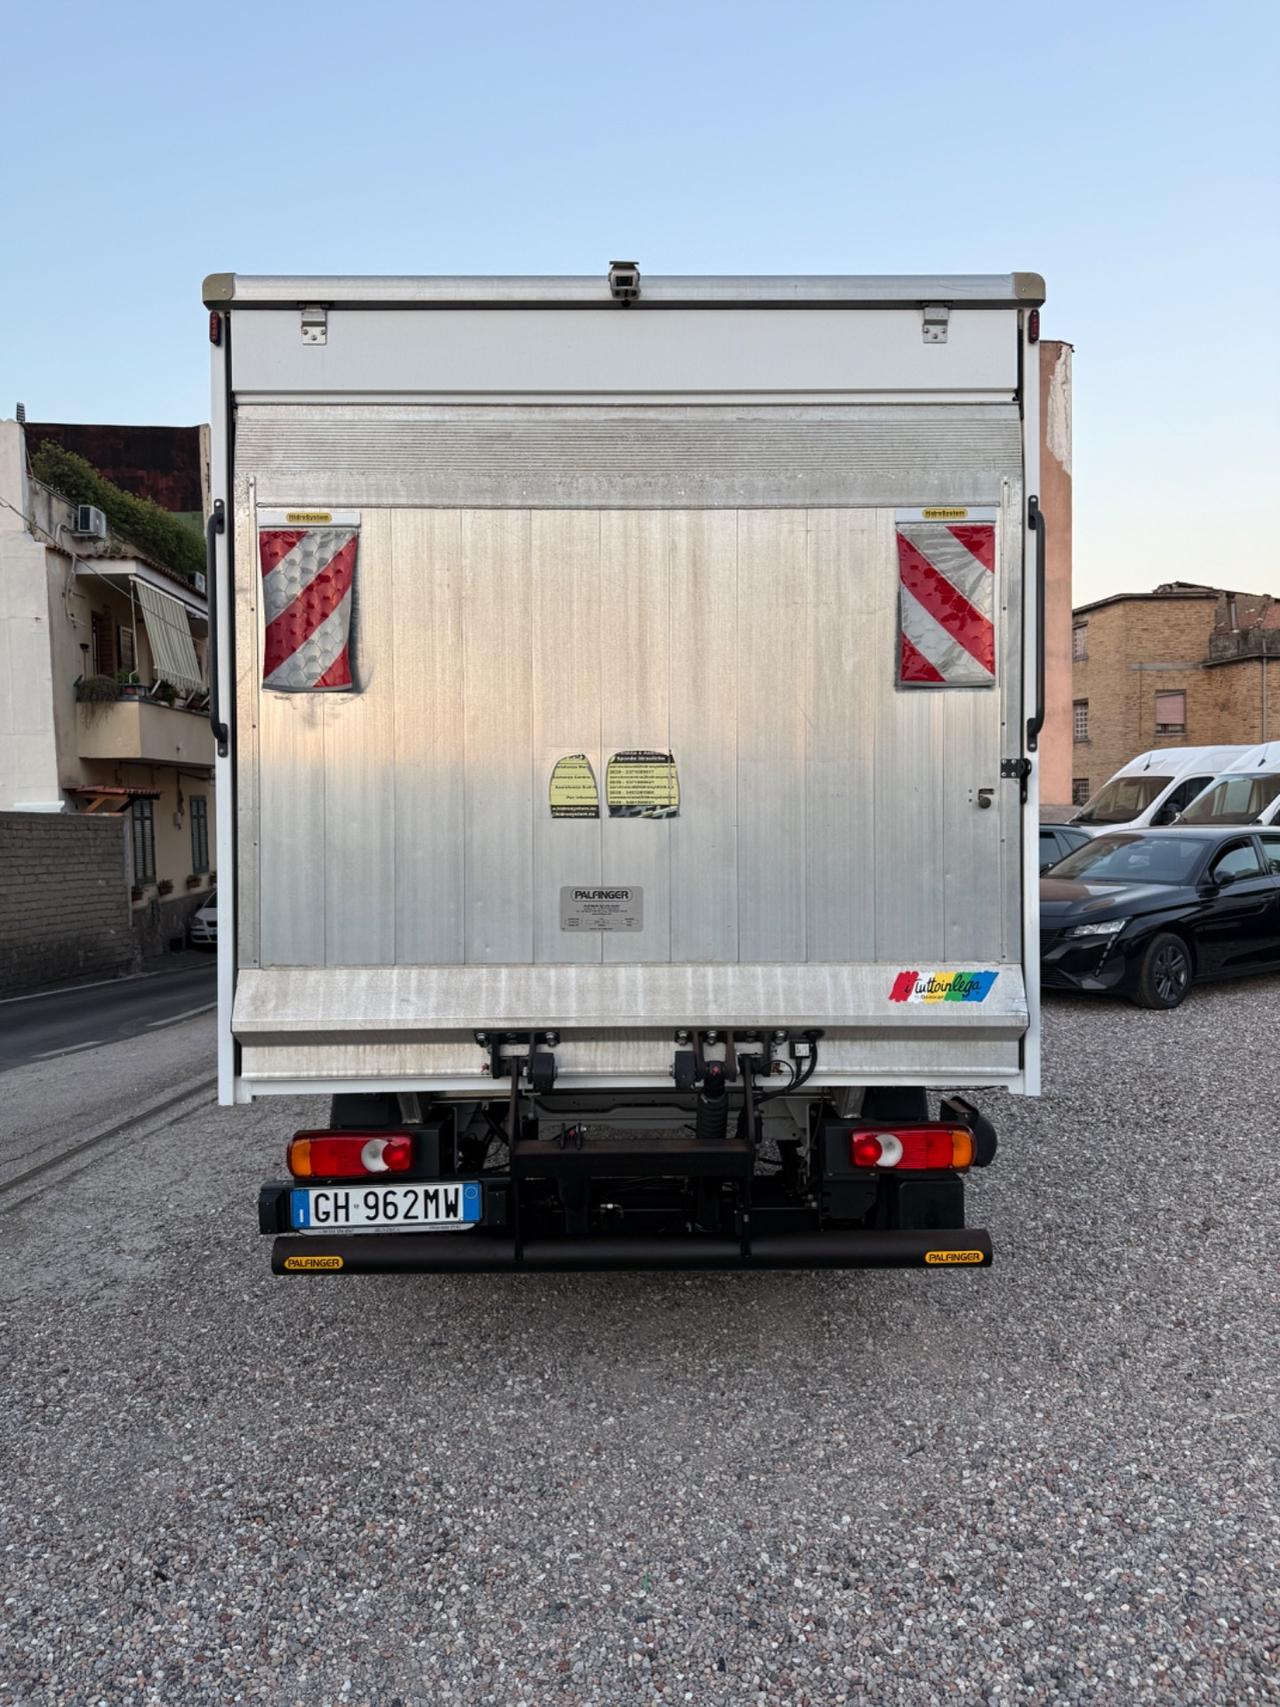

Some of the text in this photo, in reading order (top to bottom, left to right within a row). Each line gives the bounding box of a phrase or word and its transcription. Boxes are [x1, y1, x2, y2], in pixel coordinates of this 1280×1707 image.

[574, 890, 629, 900] PALFINGER
[314, 1187, 460, 1223] GH 962MW
[928, 1252, 980, 1262] PALFINGER
[287, 1258, 340, 1268] PALFINGER
